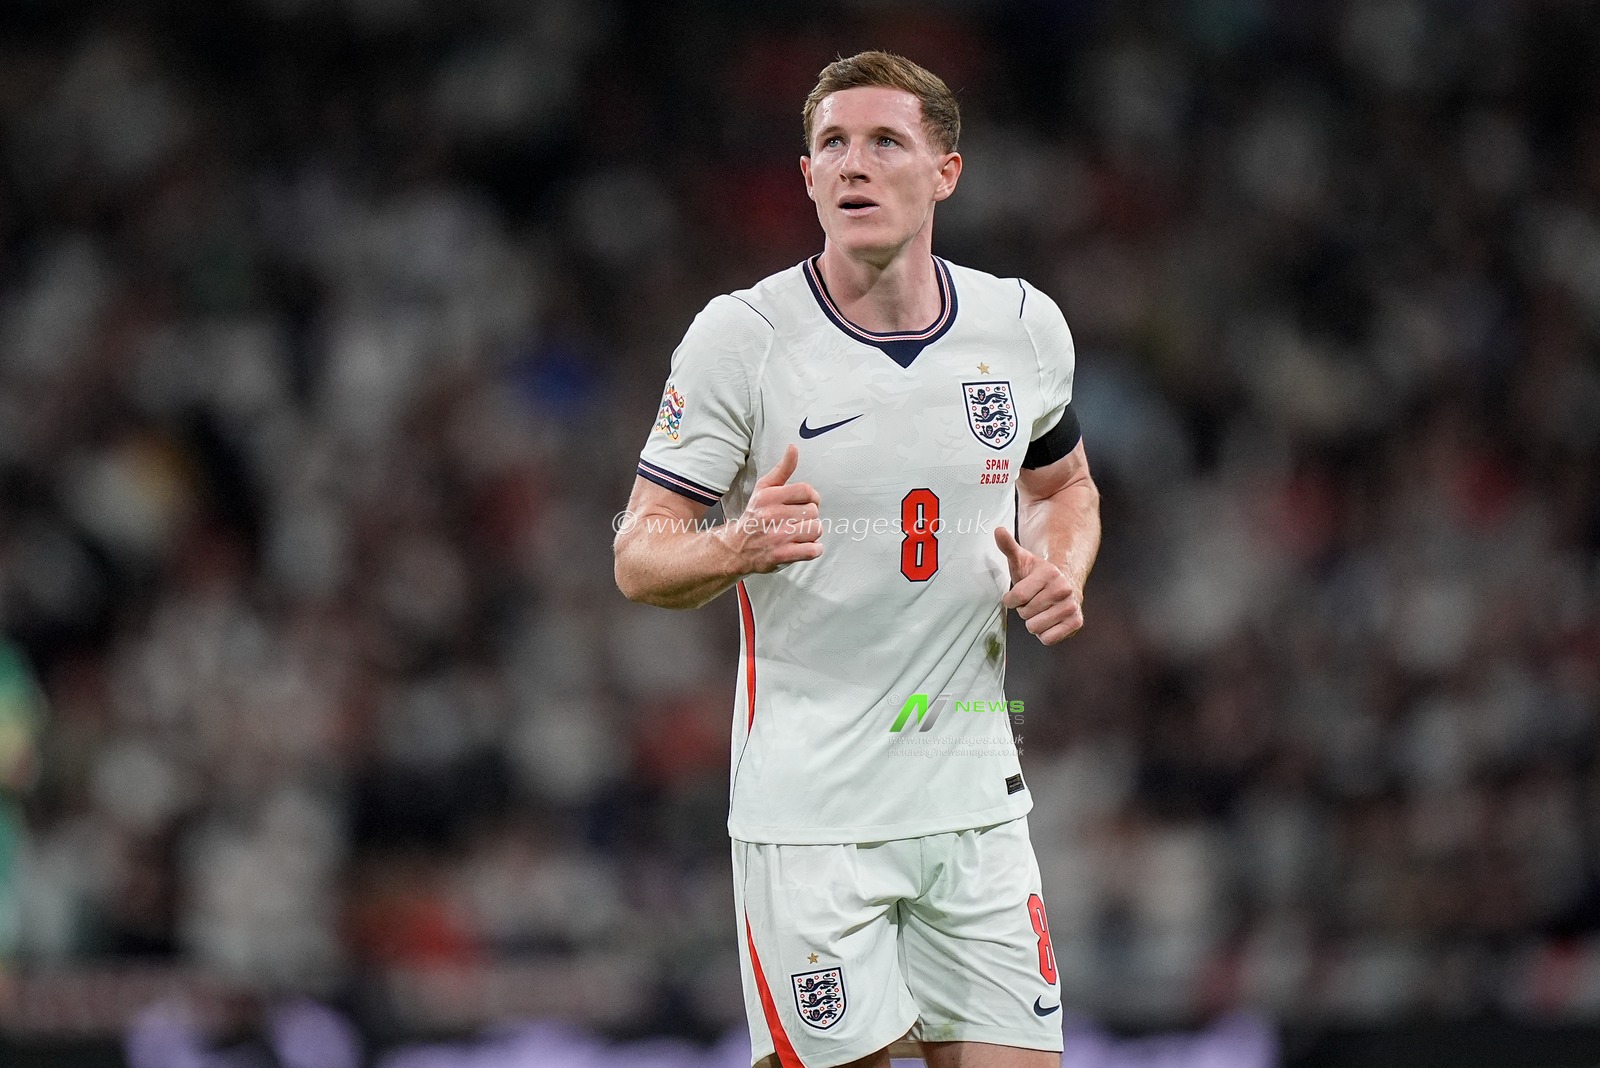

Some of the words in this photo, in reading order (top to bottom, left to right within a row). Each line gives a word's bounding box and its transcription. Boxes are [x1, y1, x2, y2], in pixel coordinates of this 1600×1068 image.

[980, 473, 1010, 485] 26.09.26
[985, 459, 1010, 471] SPAIN
[900, 487, 940, 583] 8
[1026, 893, 1058, 986] 8
